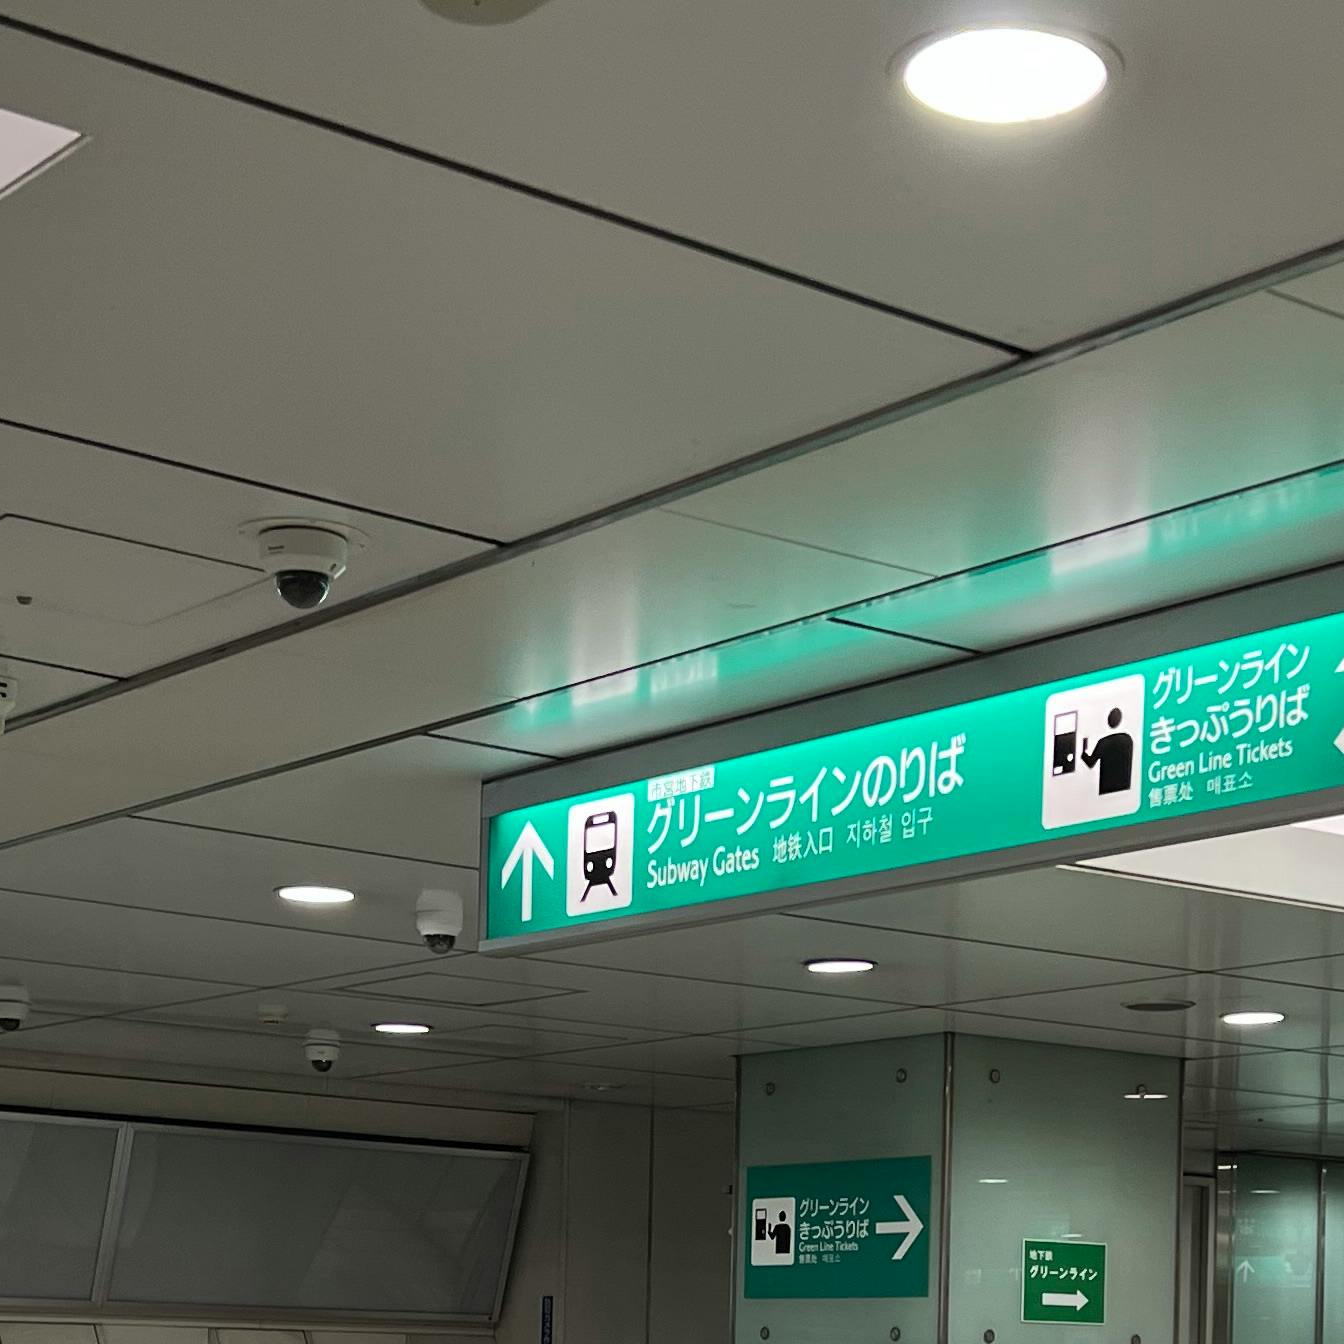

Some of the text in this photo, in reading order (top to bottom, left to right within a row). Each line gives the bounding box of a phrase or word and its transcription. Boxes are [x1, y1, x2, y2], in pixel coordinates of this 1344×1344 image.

[1152, 642, 1311, 711] グリーンライン
[1149, 683, 1310, 754] きっぷうりば
[1148, 738, 1293, 784] Green Line Tickets
[647, 733, 967, 855] グリーンラインのりば
[1148, 782, 1193, 809] 售票处
[1206, 772, 1253, 795] 매표소
[772, 827, 834, 863] 地铁入口
[846, 806, 934, 849] 지하철 입구
[647, 845, 760, 888] Subway Gates
[799, 1197, 870, 1218] グリーンライン
[799, 1218, 870, 1241] きっぷうりば
[799, 1240, 859, 1252] Green Line Tickets
